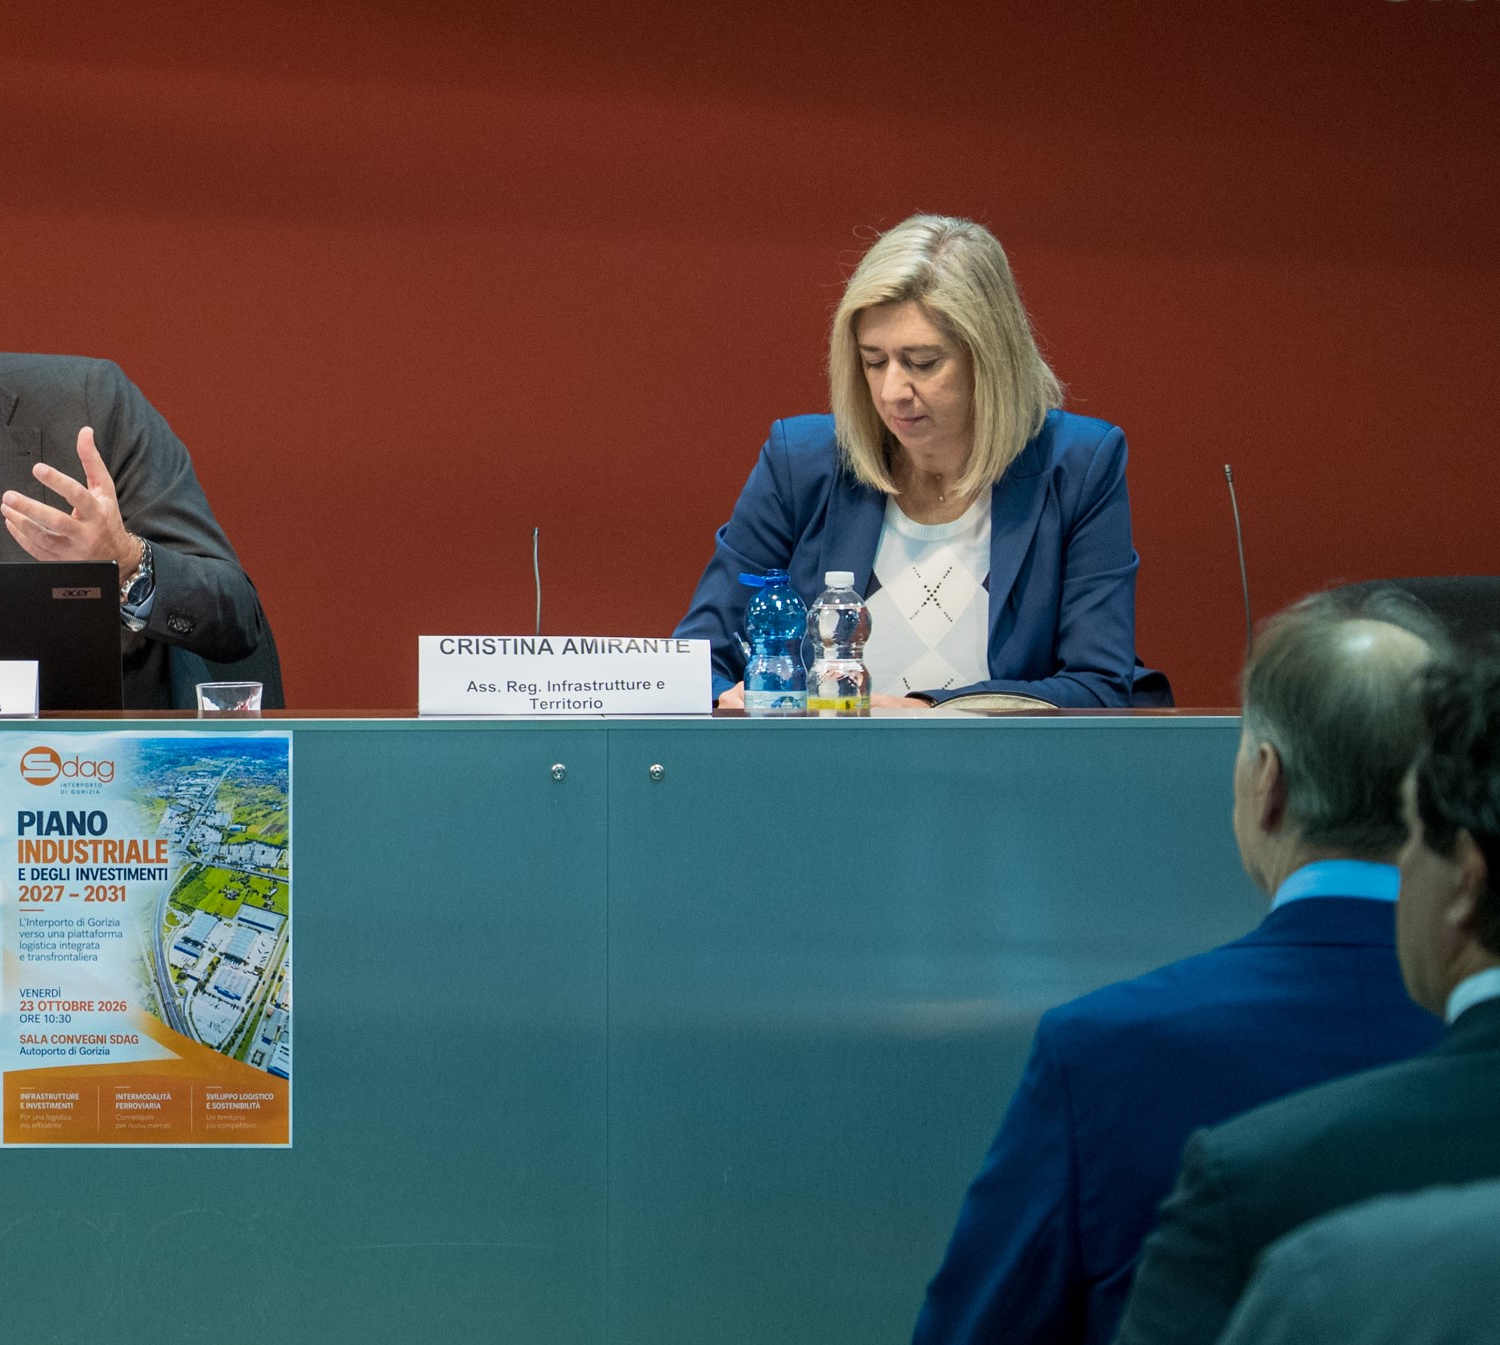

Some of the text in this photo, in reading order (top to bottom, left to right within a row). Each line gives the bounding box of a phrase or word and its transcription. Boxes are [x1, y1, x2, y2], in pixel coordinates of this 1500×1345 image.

[62, 589, 91, 598] acer
[439, 638, 691, 655] CRISTINA AMIRANTE
[466, 679, 665, 696] Ass. Reg. Infrastrutture e
[529, 697, 604, 710] Territorio
[20, 746, 115, 786] Sdag
[17, 810, 108, 837] PIANO
[17, 839, 169, 864] INDUSTRIALE
[18, 867, 168, 881] E DEGLI INVESTIMENTI
[18, 885, 65, 902] 2027
[83, 885, 126, 902] 2031
[76, 918, 85, 927] di
[87, 918, 121, 927] Gorizia
[19, 929, 123, 940] verso una piattaforma
[19, 941, 100, 952] logistica integrata
[27, 952, 98, 961] transfrontaliera
[19, 987, 61, 998] VENERDÌ
[19, 1000, 127, 1012] 23 OTTOBRE 2026
[19, 1014, 72, 1023] ORE 10:30
[19, 1034, 139, 1044] SALA CONVEGNI SDAG
[19, 1046, 110, 1057] Autoporto di Gorizia
[115, 1092, 172, 1100] INTERMODALITÀ
[212, 1101, 261, 1109] SOSTENIBILITÀ
